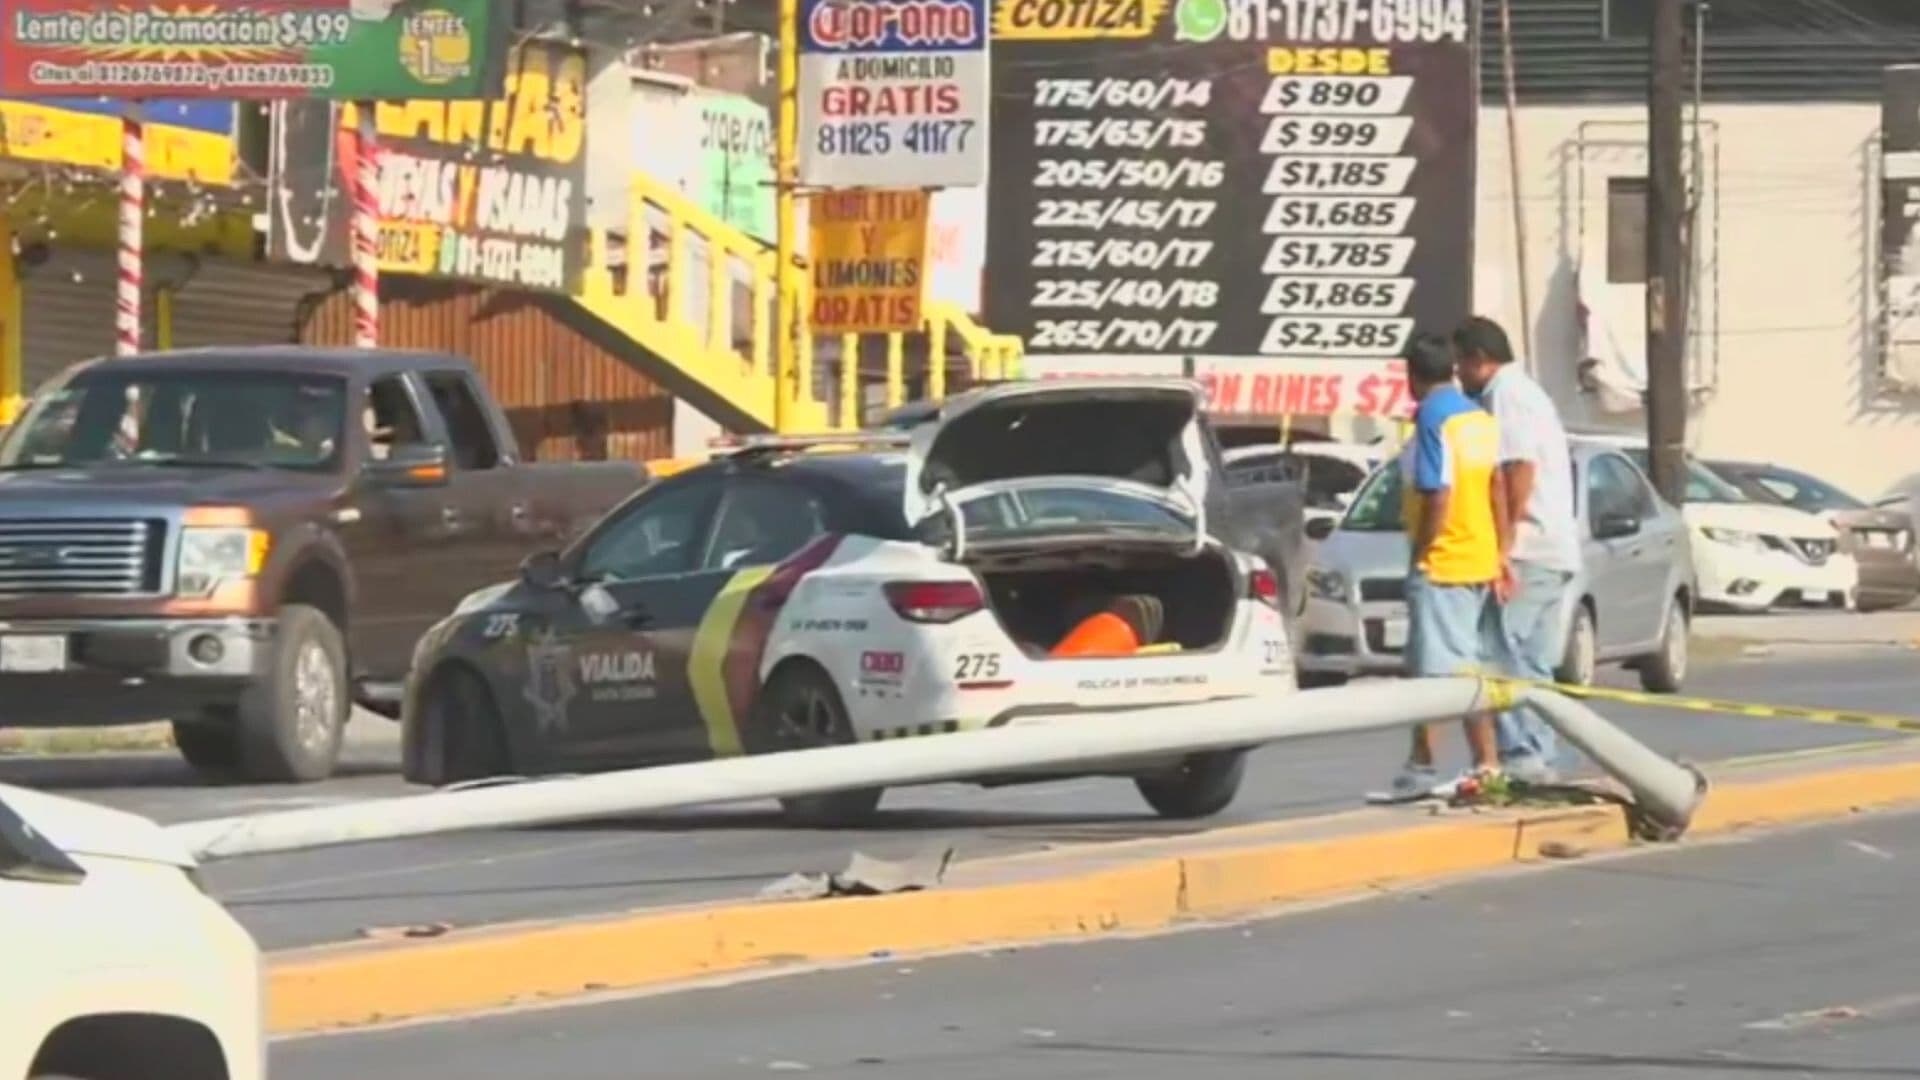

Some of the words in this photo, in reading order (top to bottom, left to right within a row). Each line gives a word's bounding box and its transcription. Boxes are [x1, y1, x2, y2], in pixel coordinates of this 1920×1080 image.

[15, 12, 82, 42] Lente
[88, 12, 122, 41] de
[133, 8, 274, 44] Promoción
[281, 13, 349, 45] $499
[809, 0, 976, 48] Corona
[1010, 0, 1145, 28] COTIZA
[1267, 47, 1391, 75] DESDE
[822, 84, 960, 116] GRATIS
[1032, 77, 1213, 109] 175/60/14
[1277, 80, 1303, 107] $
[1307, 82, 1381, 107] 890
[817, 121, 891, 155] 81125
[1032, 118, 1208, 149] 175/65/15
[1277, 120, 1302, 148] $
[1308, 122, 1378, 147] 999
[1032, 158, 1225, 189] 205/50/16
[1280, 159, 1389, 189] $1,185
[1032, 199, 1217, 231] 225/45/17
[1279, 201, 1397, 229] $1,685
[1031, 239, 1215, 270] 215/60/17
[1279, 241, 1394, 269] $1,785
[815, 257, 918, 289] LIMONES
[815, 294, 915, 325] GRATIS
[1030, 278, 1219, 311] 225/40/18
[1278, 281, 1397, 310] $1,865
[1029, 318, 1218, 350] 265/70/17
[1278, 321, 1401, 350] $2,585
[1252, 374, 1343, 414] RINES
[954, 653, 1000, 679] 275
